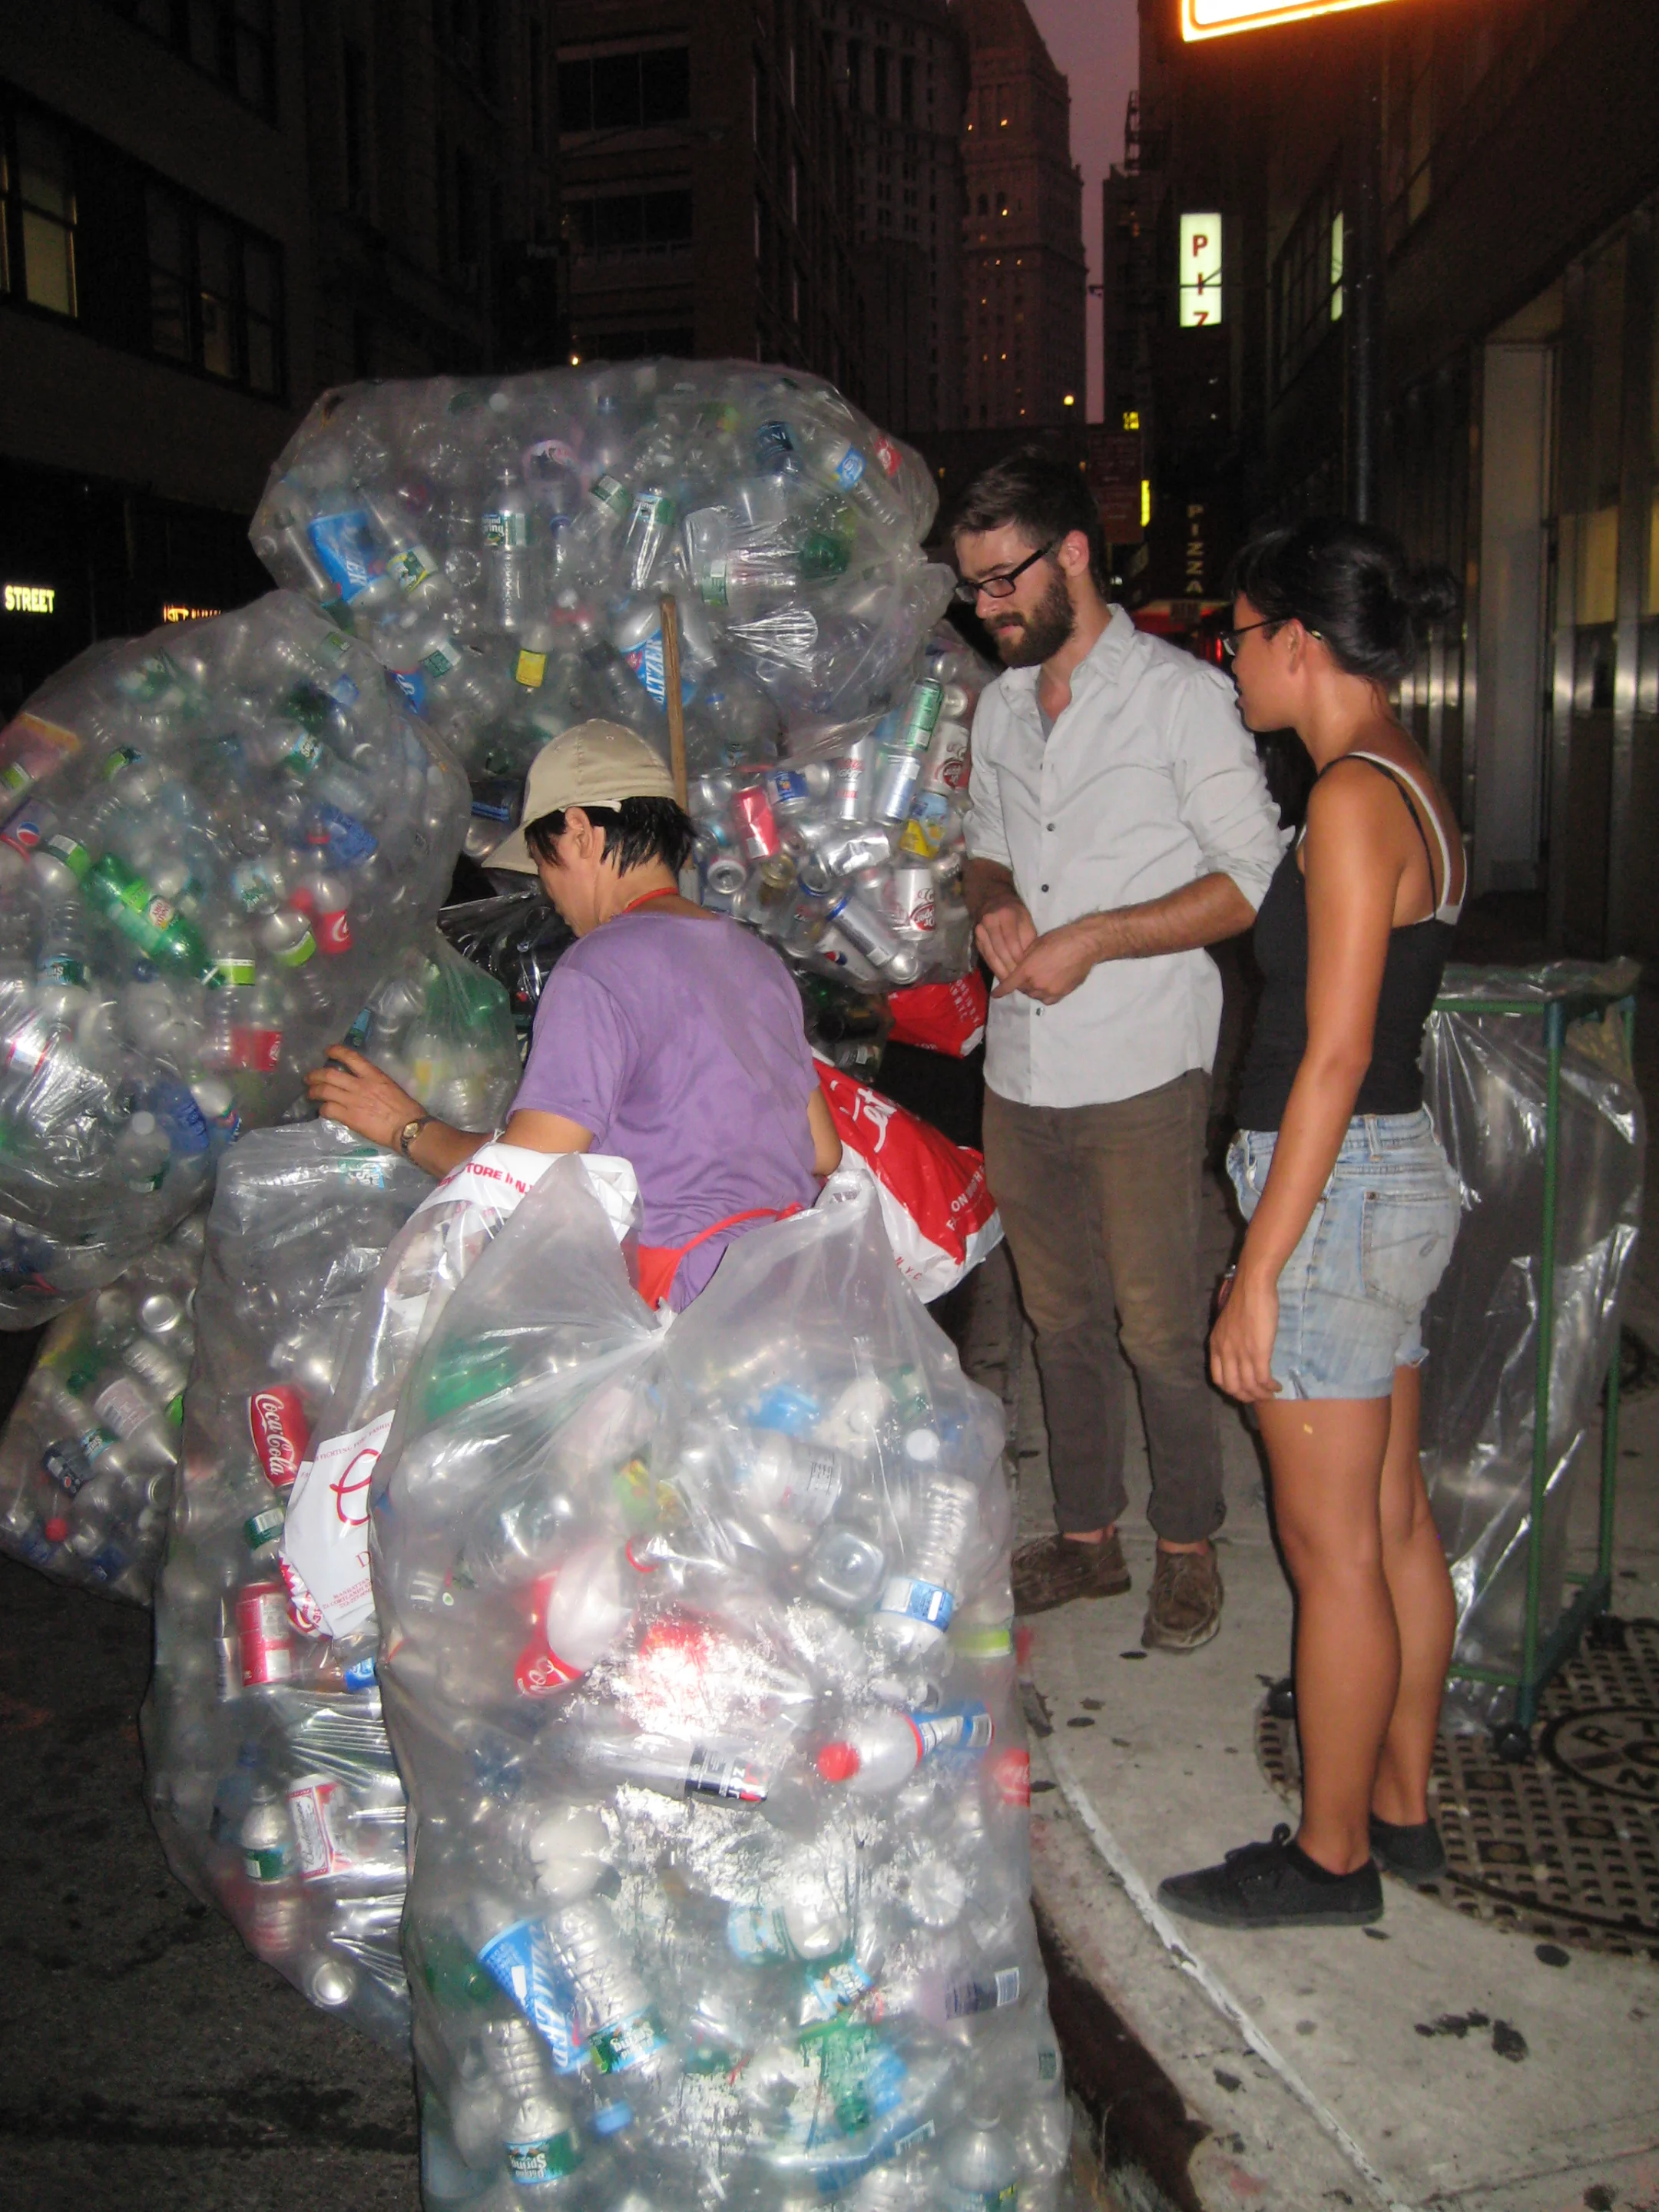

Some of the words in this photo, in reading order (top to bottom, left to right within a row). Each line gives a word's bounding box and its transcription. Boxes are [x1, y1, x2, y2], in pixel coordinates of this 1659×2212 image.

[1186, 504, 1204, 594] PIZZA
[5, 585, 55, 614] STREET
[465, 1162, 503, 1181] TORE
[255, 1393, 298, 1475] Coca-Cola
